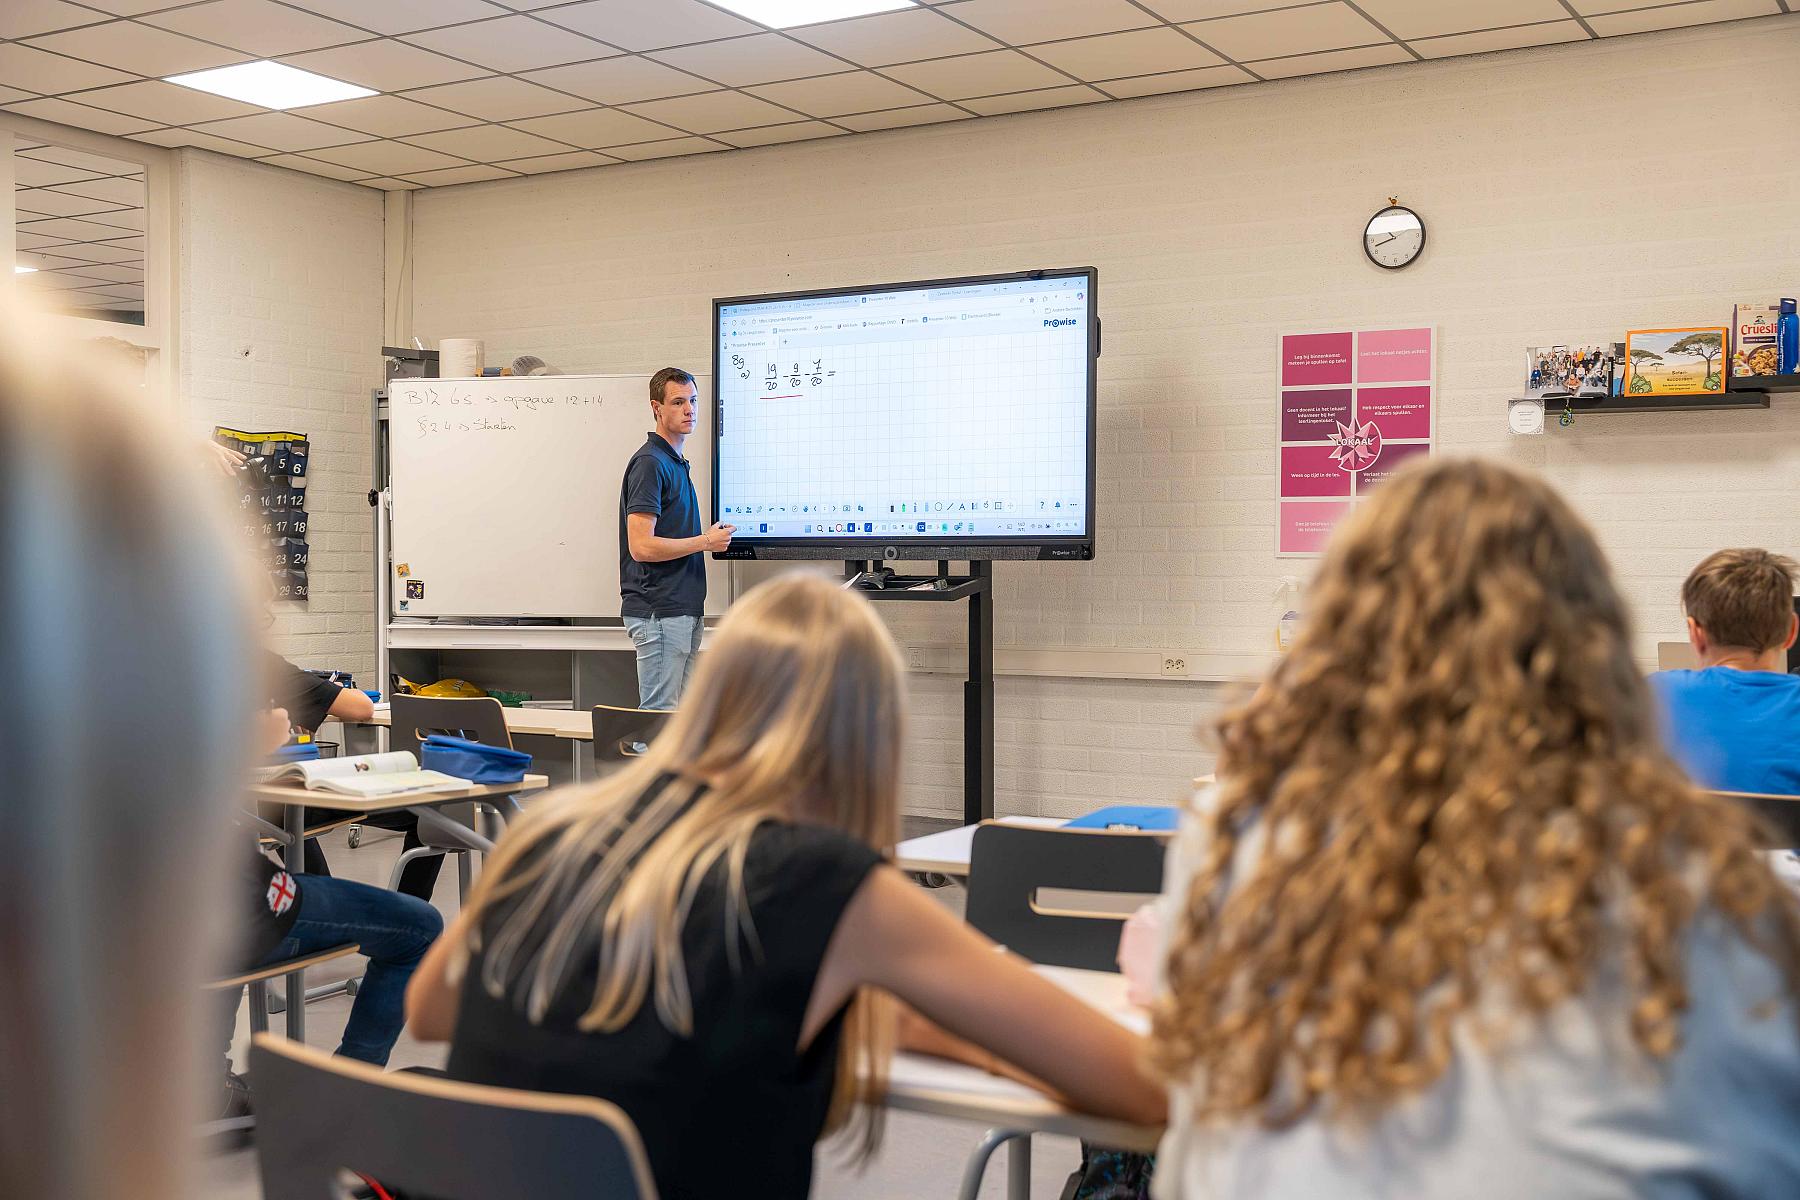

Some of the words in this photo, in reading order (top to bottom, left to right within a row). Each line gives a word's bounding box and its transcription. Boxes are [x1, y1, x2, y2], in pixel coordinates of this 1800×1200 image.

[1044, 318, 1076, 327] Prowise
[1741, 323, 1777, 335] Cruesli
[765, 382, 777, 390] 20
[790, 378, 801, 387] 20
[810, 376, 822, 386] 20
[504, 396, 554, 410] opgave
[1336, 438, 1373, 446] LOKAAL
[279, 458, 286, 468] 5
[293, 464, 301, 473] 6
[277, 494, 287, 504] 11
[290, 495, 303, 505] 12
[276, 521, 287, 532] 17
[294, 522, 306, 532] 18
[276, 554, 286, 565] 23
[294, 554, 307, 564] 24
[280, 585, 290, 596] 29
[294, 586, 308, 595] 30
